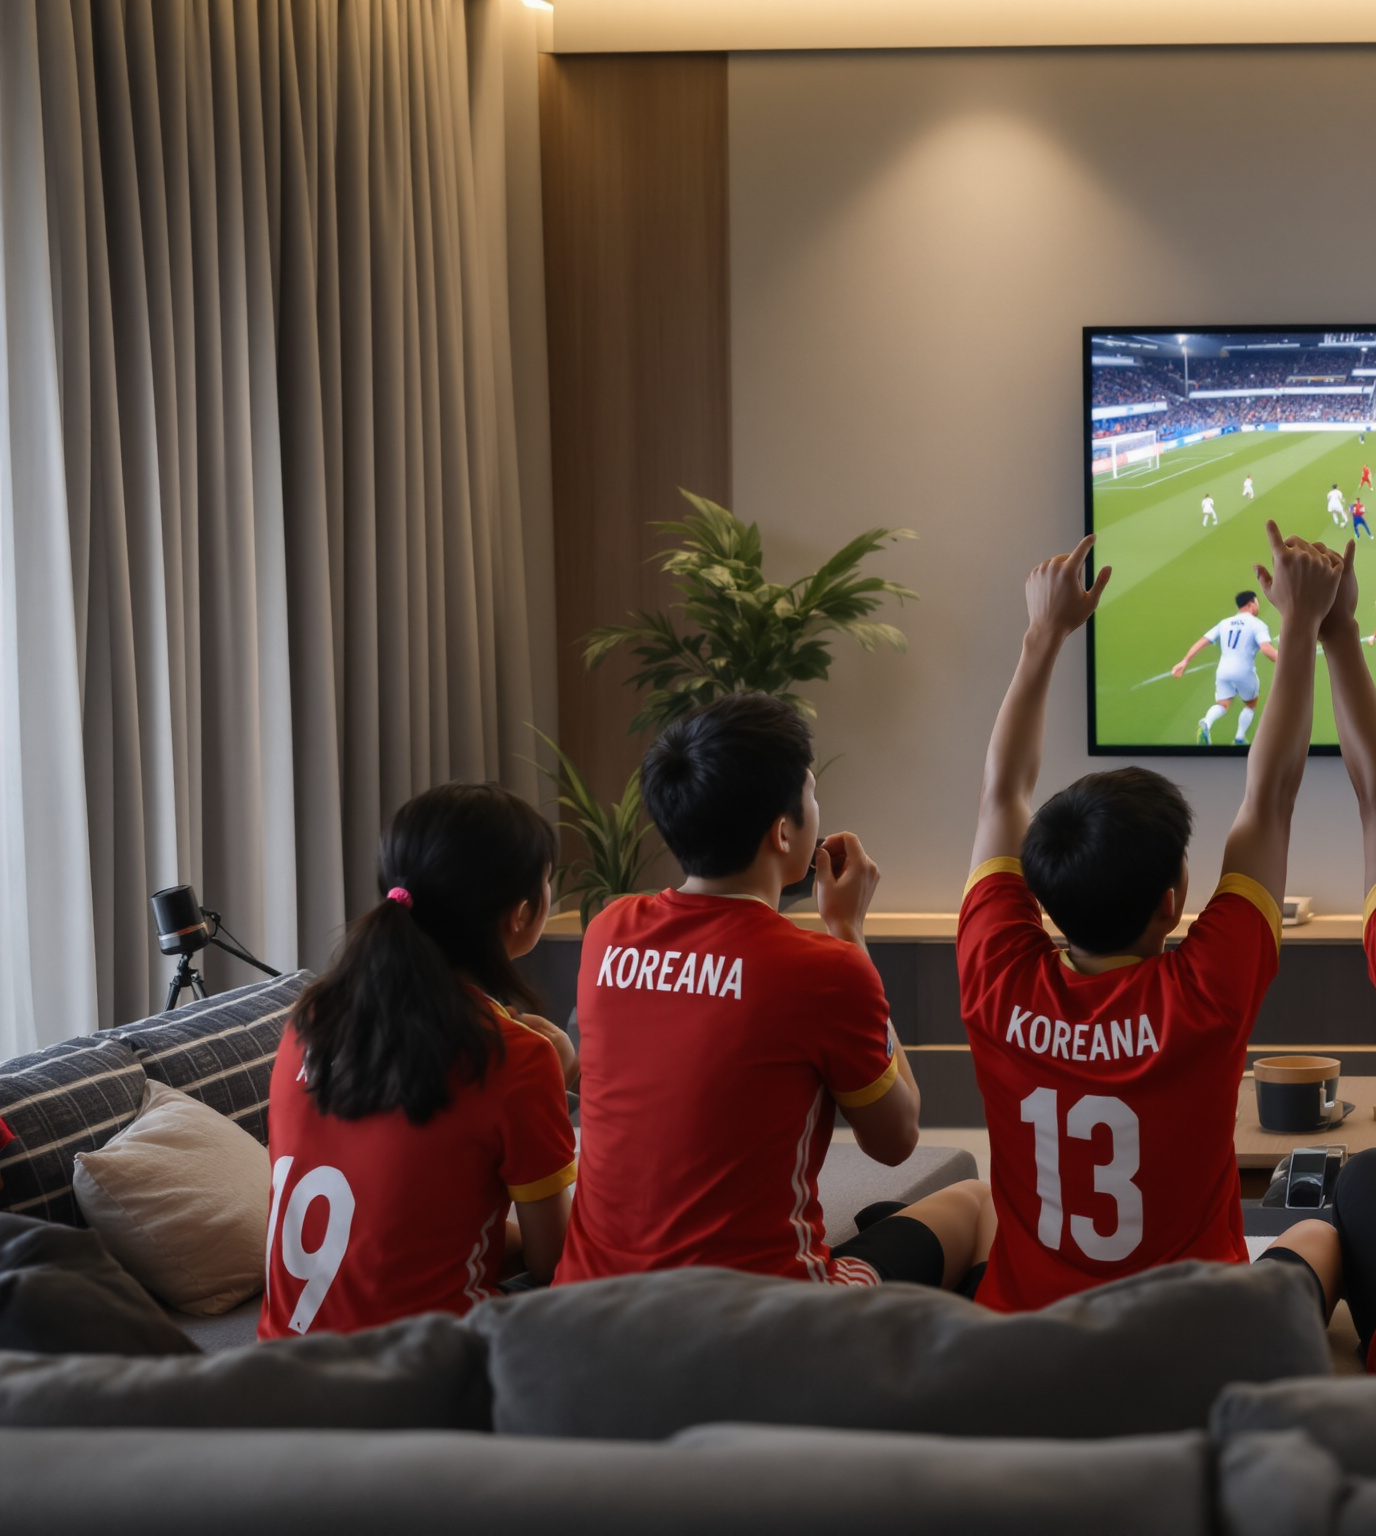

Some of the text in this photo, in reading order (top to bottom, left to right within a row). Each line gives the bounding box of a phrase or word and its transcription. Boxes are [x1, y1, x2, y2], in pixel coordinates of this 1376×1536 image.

[596, 945, 743, 1000] KOREANA
[1005, 1005, 1160, 1062] KOREANA
[1020, 1086, 1144, 1262] 13
[265, 1155, 356, 1336] 19
